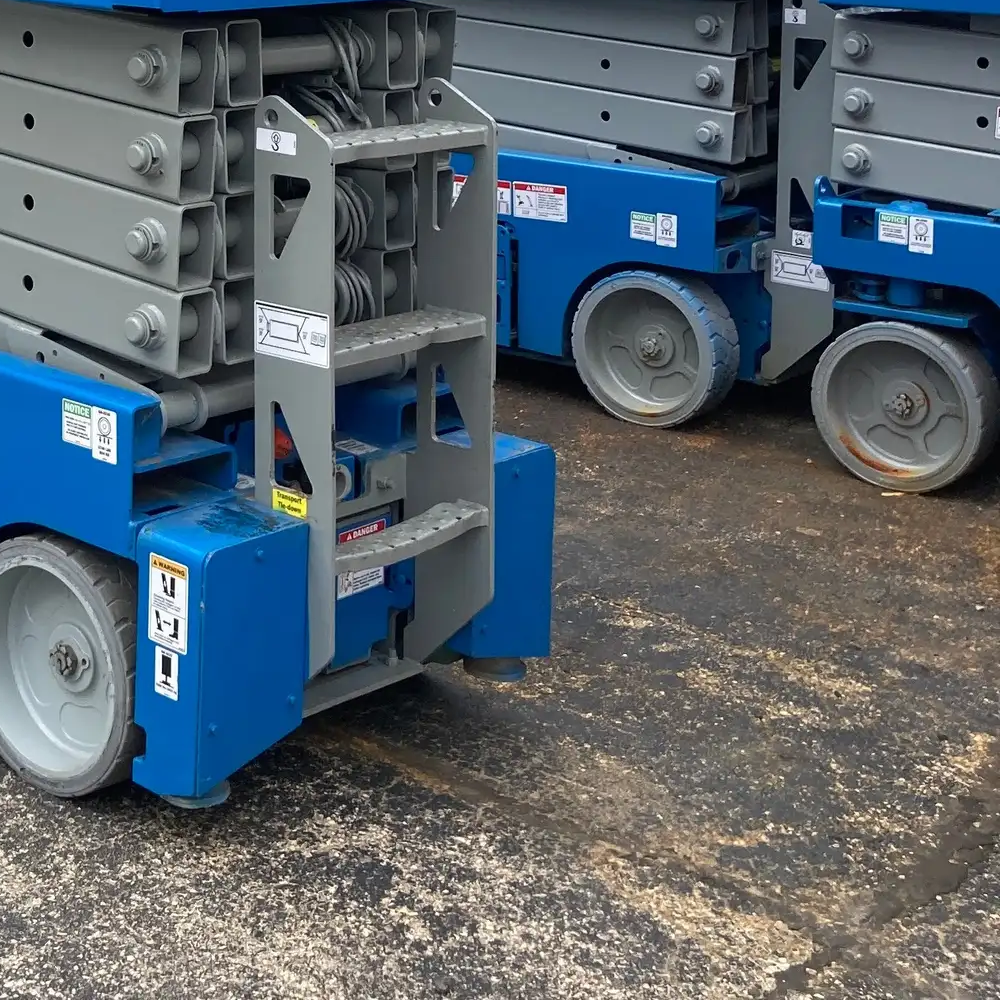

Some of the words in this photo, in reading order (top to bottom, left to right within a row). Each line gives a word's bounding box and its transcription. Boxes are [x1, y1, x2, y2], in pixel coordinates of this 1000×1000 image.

[531, 185, 554, 193] DANGER
[632, 213, 653, 222] NOTICE
[881, 214, 906, 224] NOTICE
[64, 401, 90, 418] NOTICE
[277, 491, 302, 505] Transport
[278, 501, 302, 513] Tie-down
[353, 523, 378, 539] DANGER
[159, 561, 185, 577] WARNING
